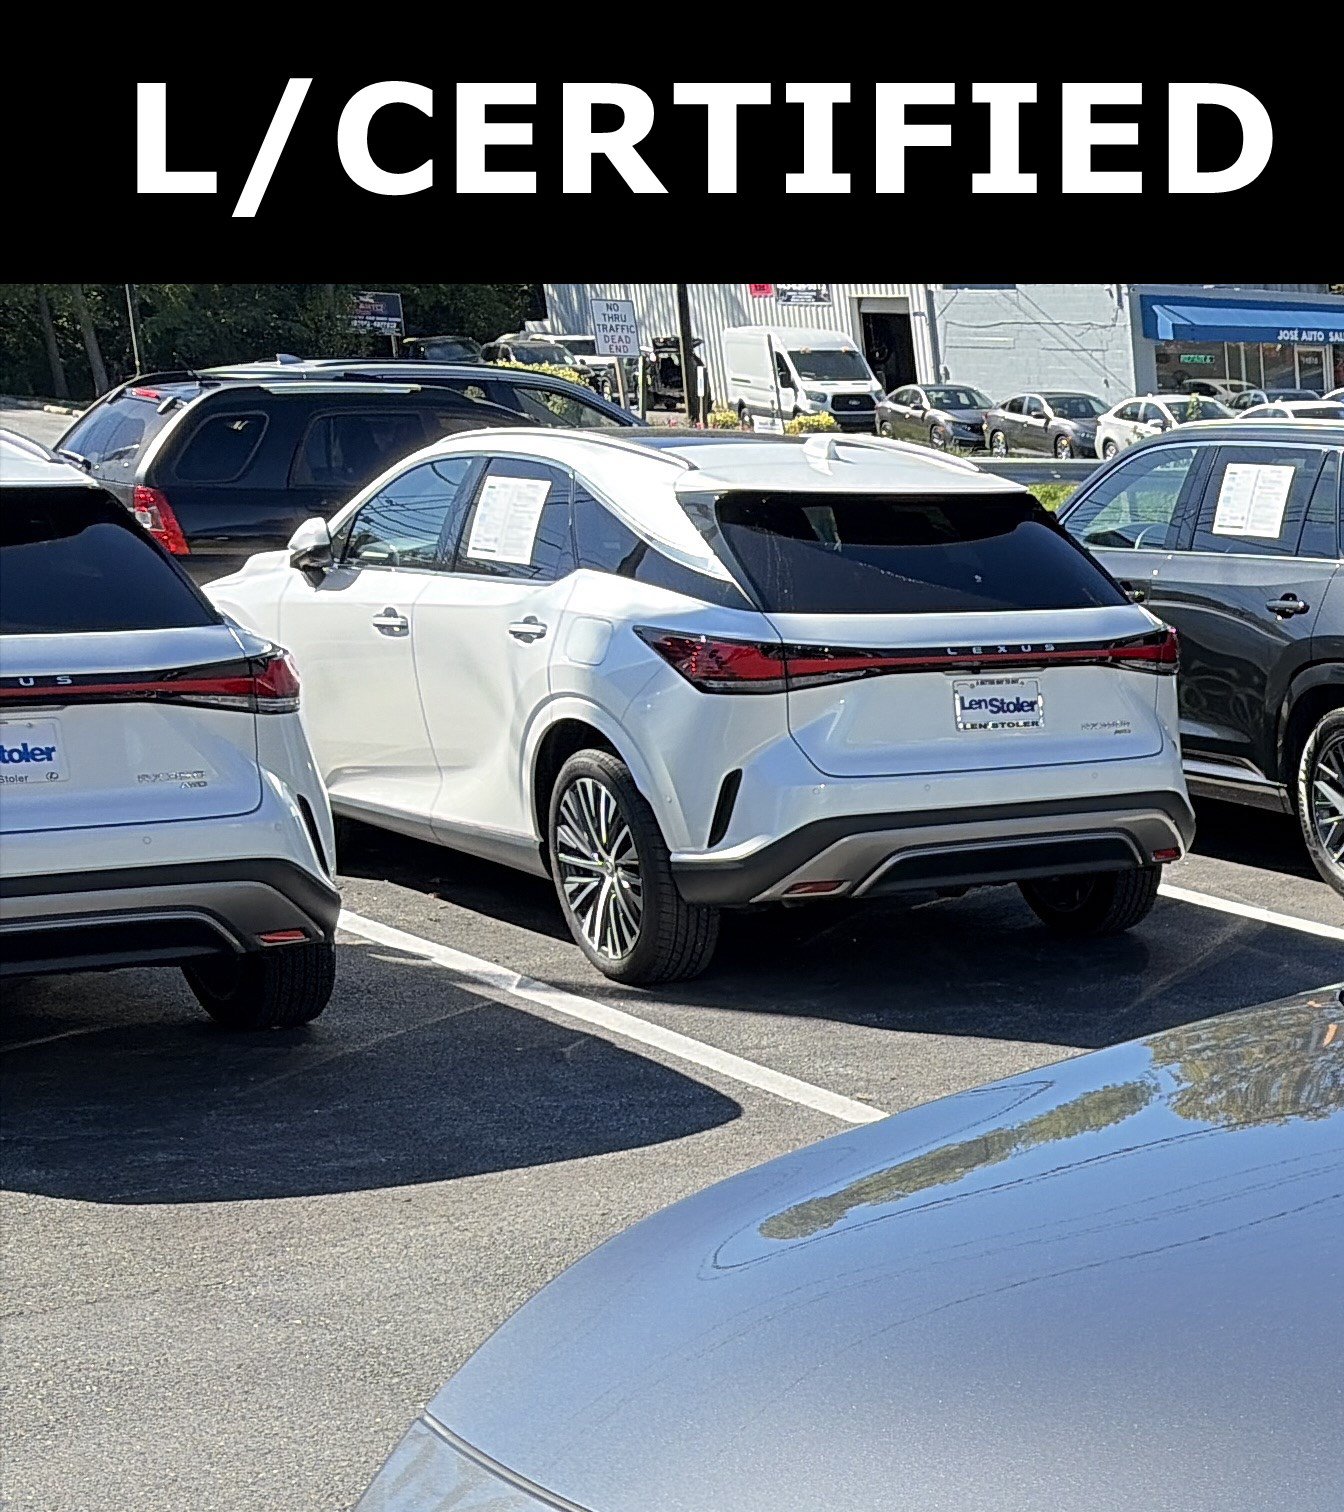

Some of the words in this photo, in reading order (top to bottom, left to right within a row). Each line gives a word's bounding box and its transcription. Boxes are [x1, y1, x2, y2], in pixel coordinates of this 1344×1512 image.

[606, 303, 620, 312] NO
[601, 313, 627, 323] THRU
[597, 323, 636, 334] TRAFFIC
[604, 334, 632, 345] DEAD
[1301, 330, 1325, 342] AUTO
[609, 344, 629, 354] END
[947, 643, 1055, 655] LEXUS
